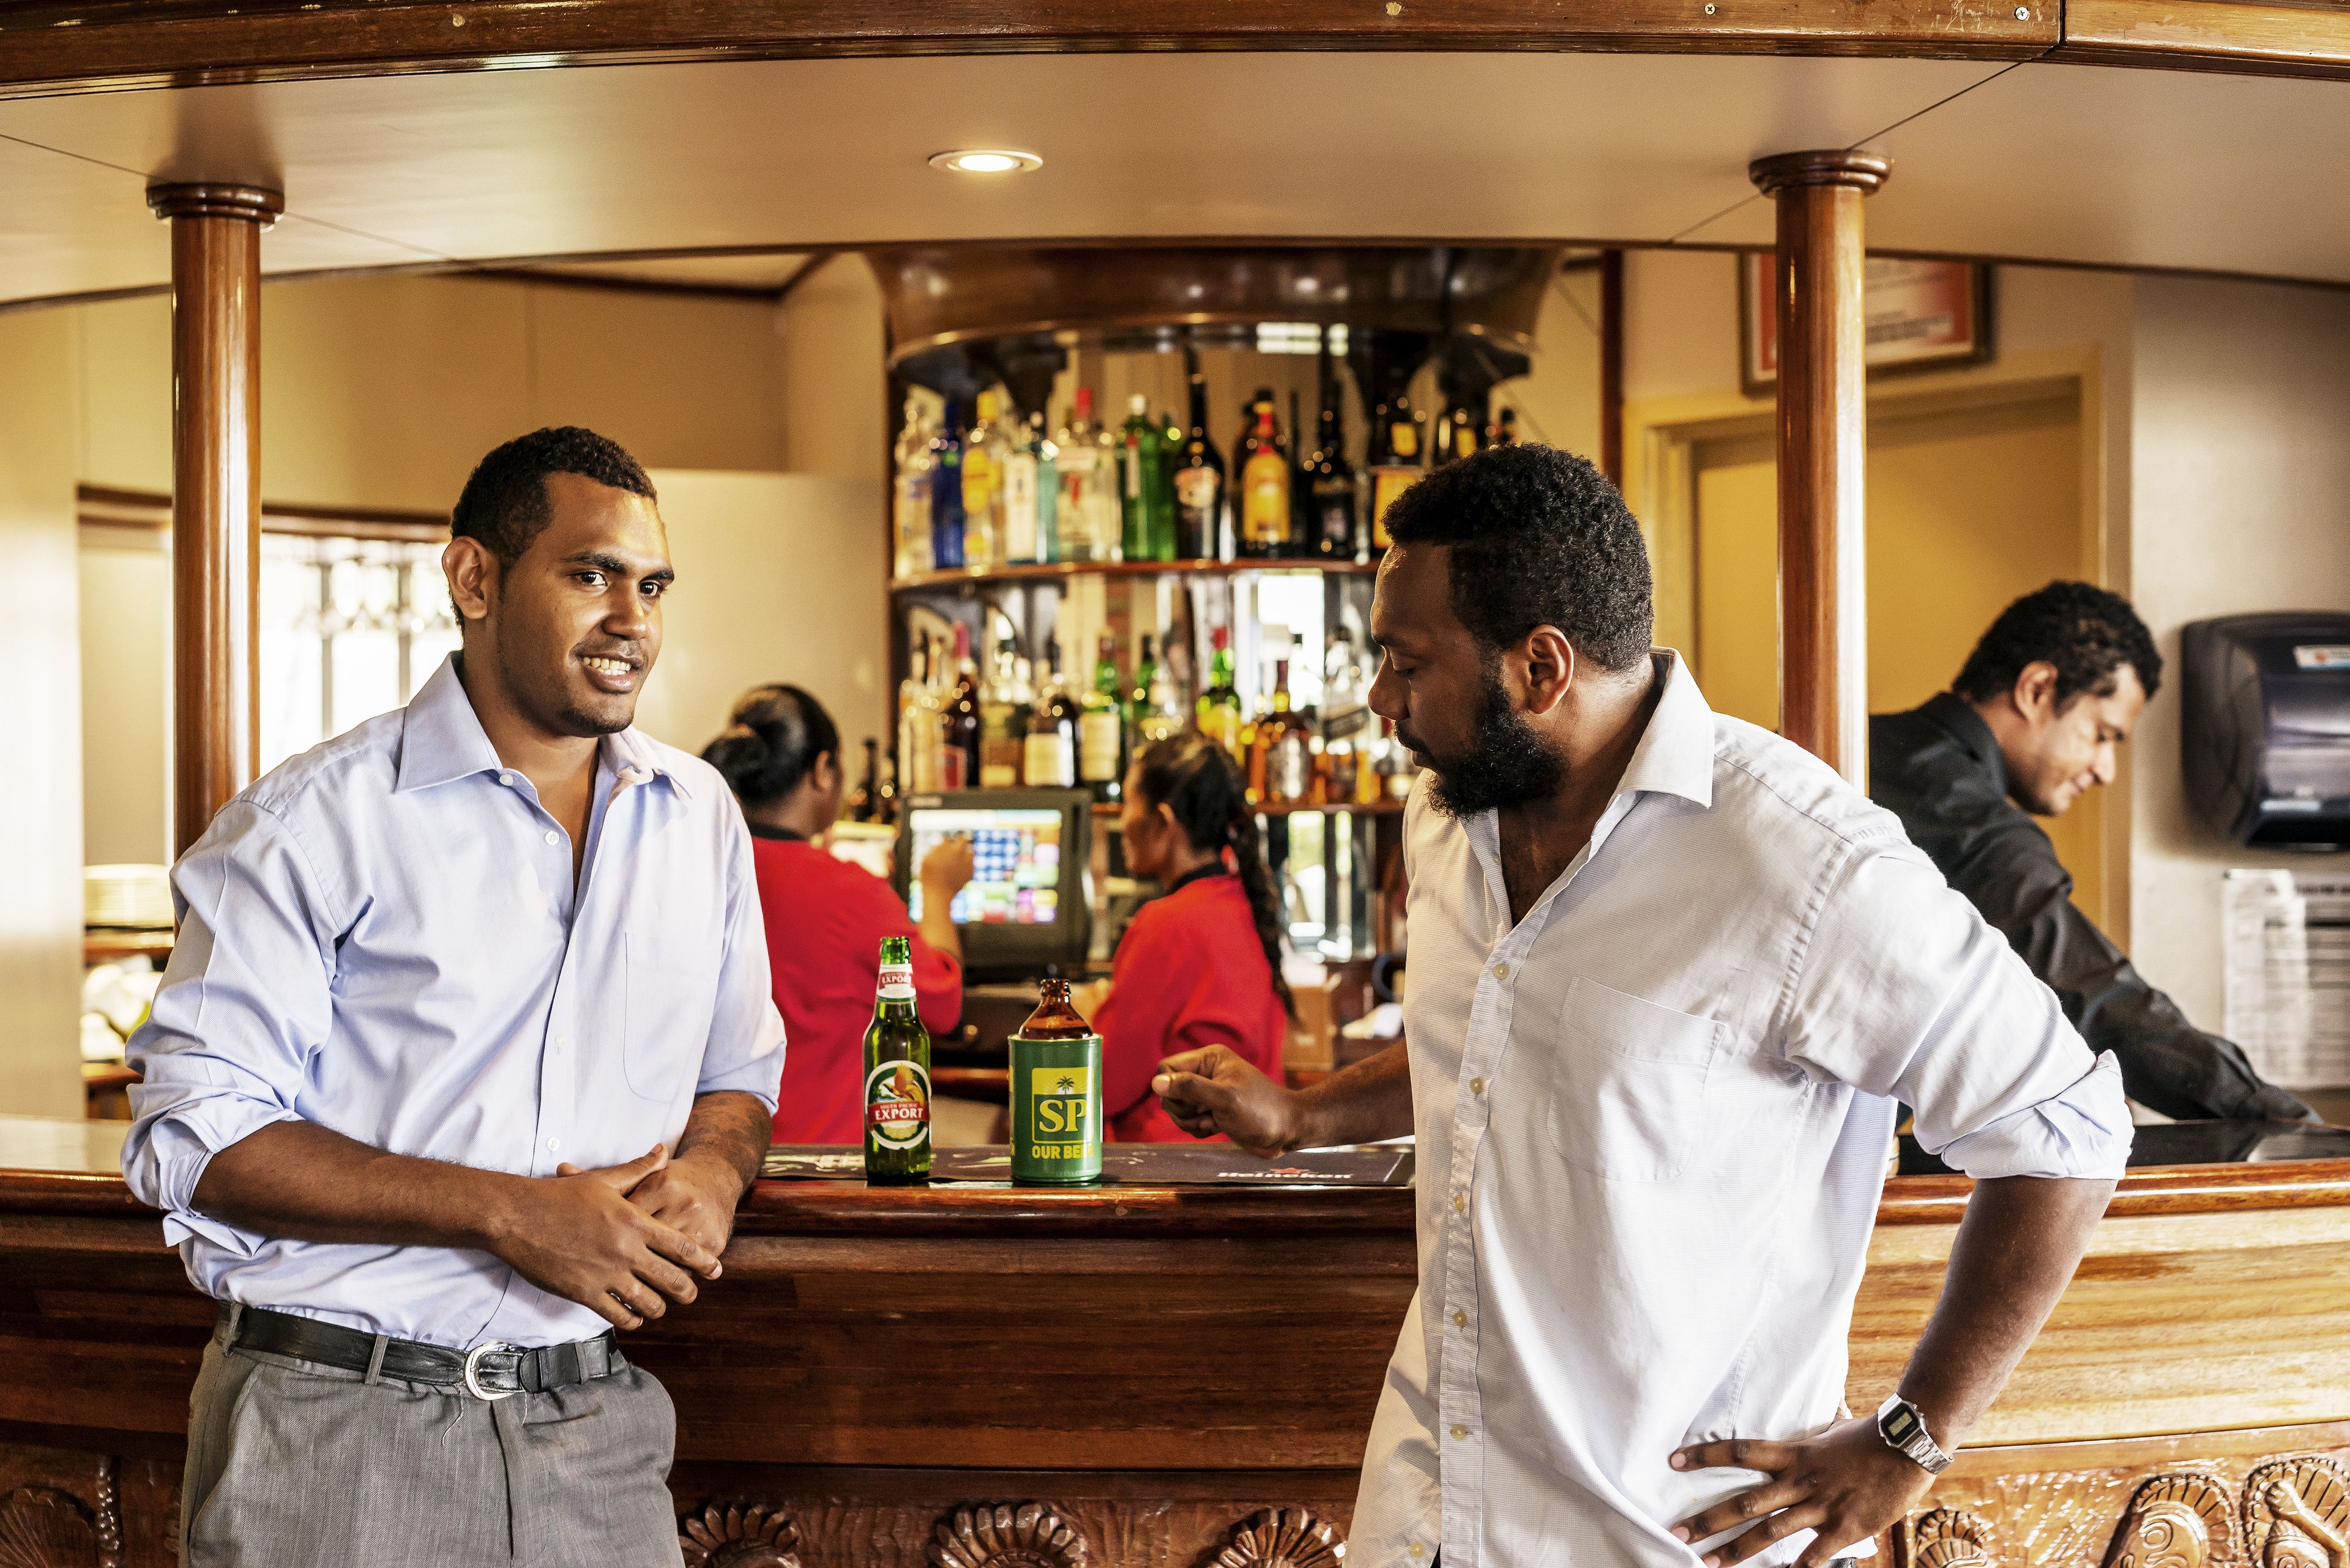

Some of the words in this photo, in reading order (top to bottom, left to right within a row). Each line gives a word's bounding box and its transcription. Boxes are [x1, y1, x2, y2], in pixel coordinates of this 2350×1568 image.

[875, 1108, 923, 1120] EXPORT
[1039, 1099, 1088, 1133] SP
[1032, 1144, 1061, 1160] OUR
